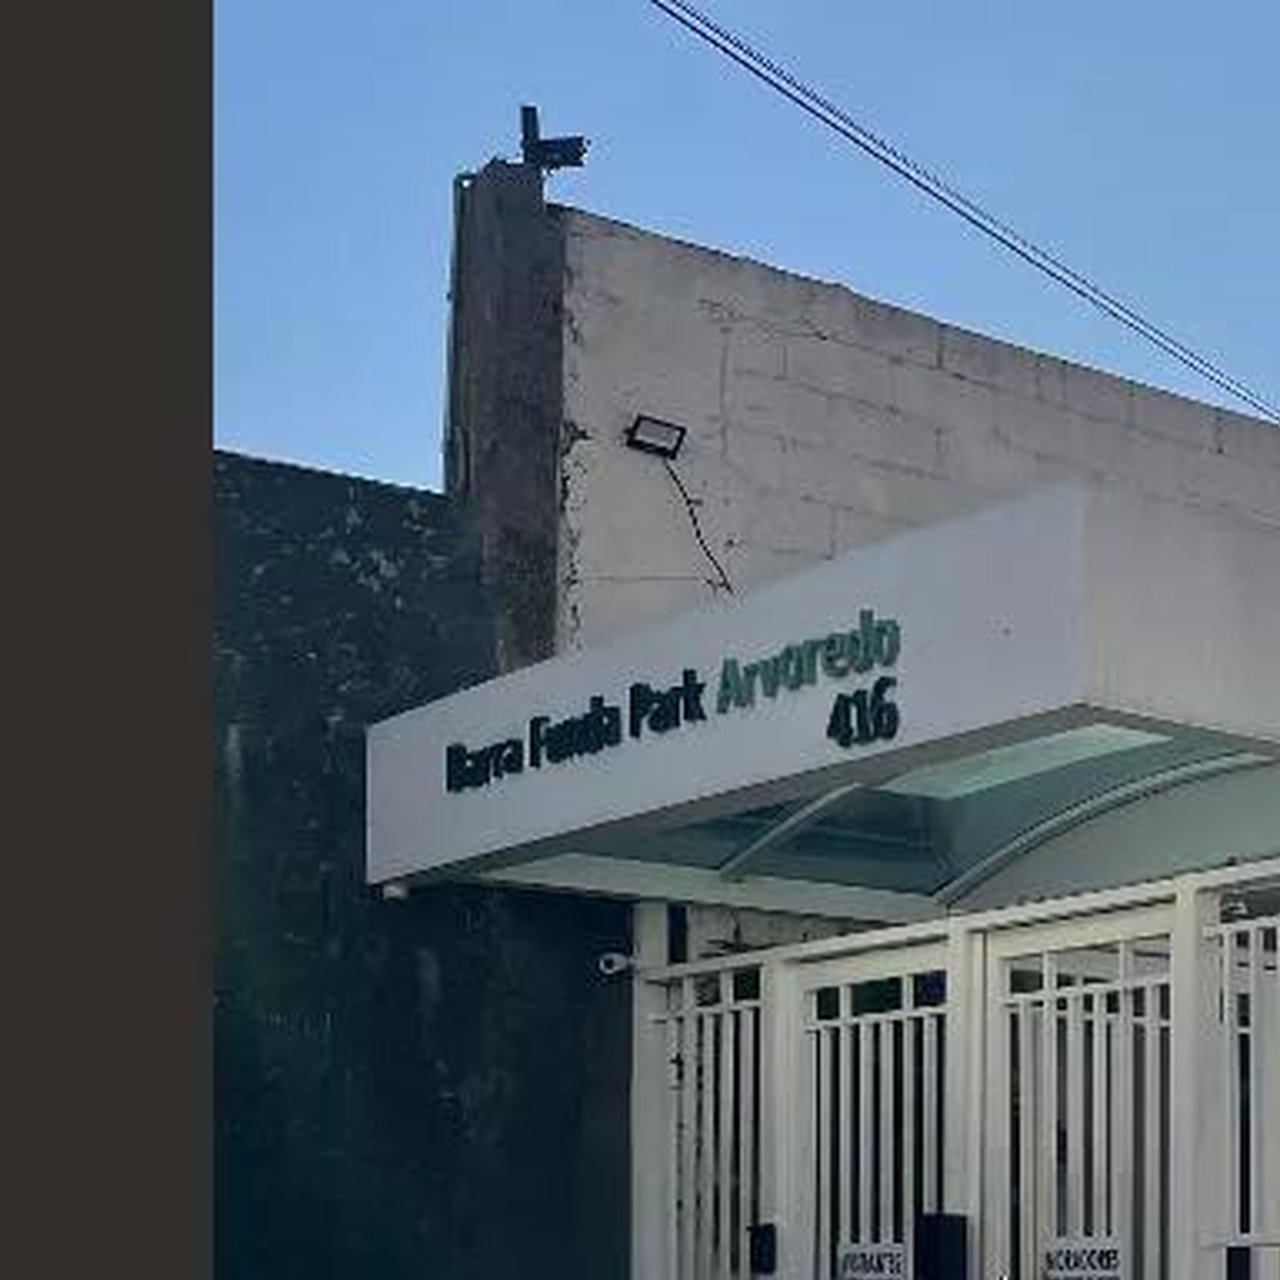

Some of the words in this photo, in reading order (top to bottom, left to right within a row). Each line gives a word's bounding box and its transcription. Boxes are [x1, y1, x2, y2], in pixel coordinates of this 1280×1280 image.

[446, 741, 524, 792] Barra
[529, 696, 621, 768] Funda
[629, 669, 707, 739] Park
[716, 609, 900, 714] Arvoredo
[826, 676, 898, 748] 416
